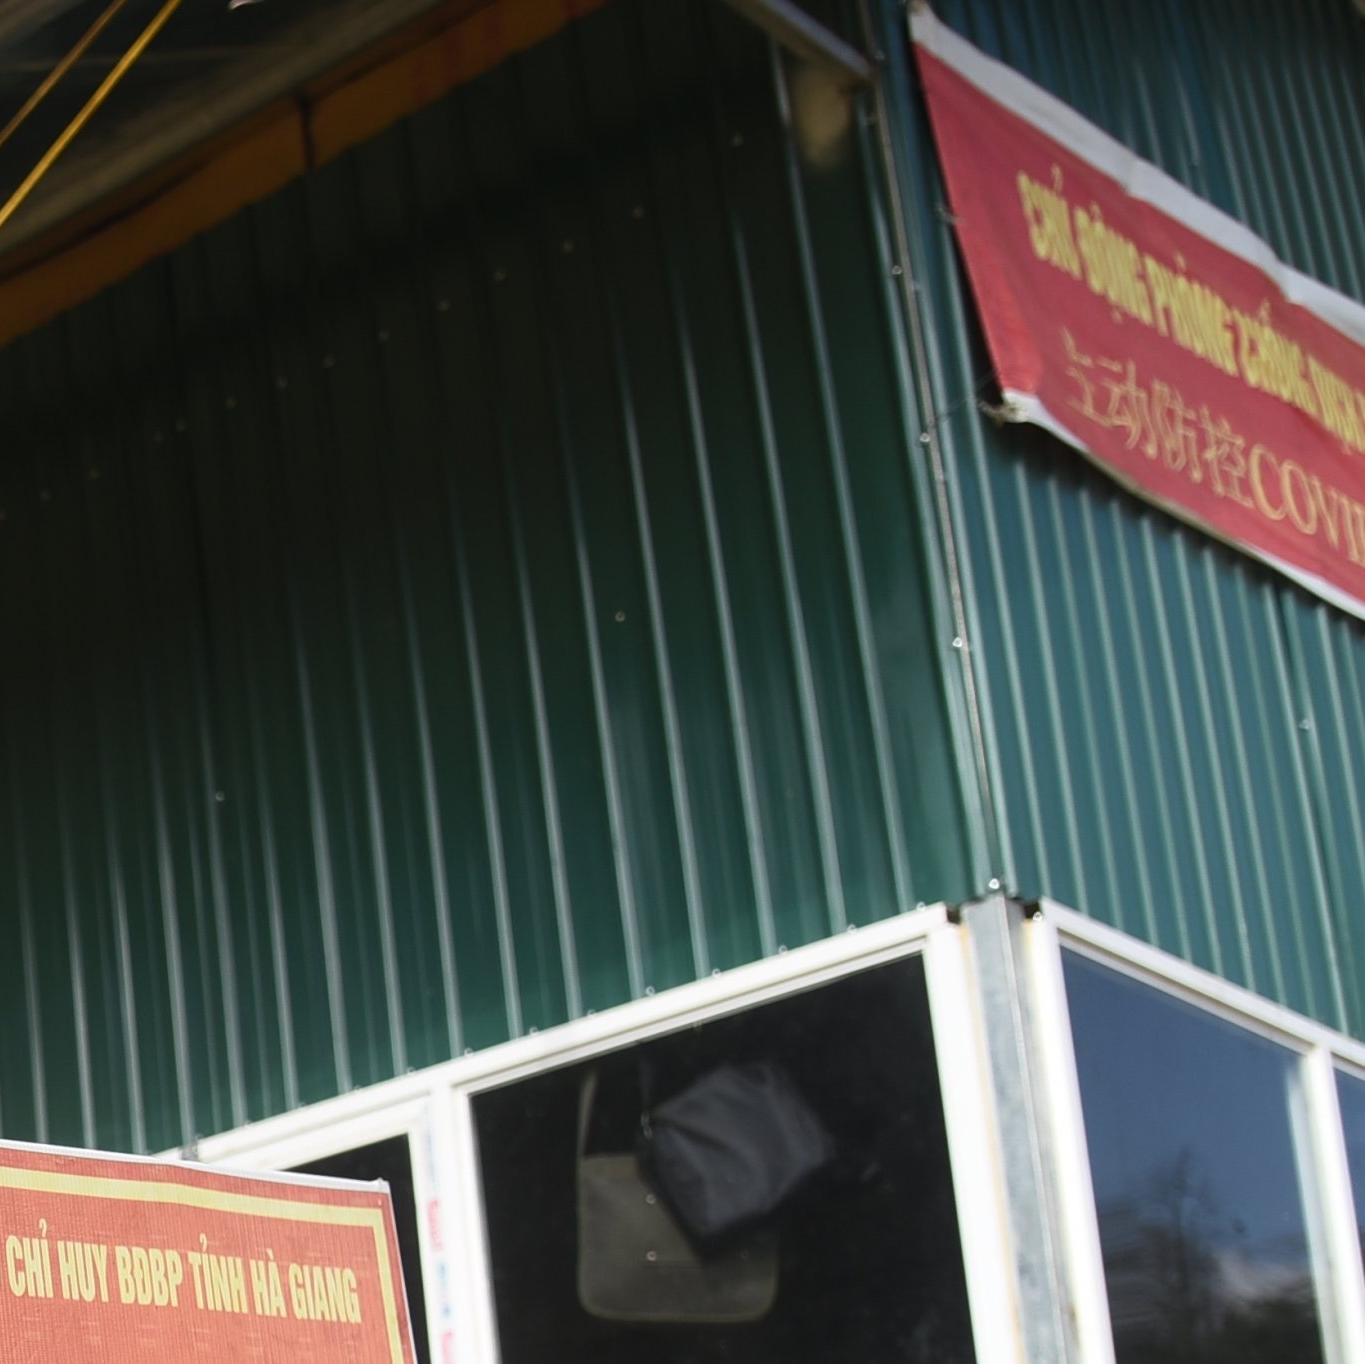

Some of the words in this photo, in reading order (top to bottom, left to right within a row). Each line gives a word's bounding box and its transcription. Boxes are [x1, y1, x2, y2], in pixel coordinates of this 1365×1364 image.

[1142, 252, 1240, 380] PHÒNG
[6, 1220, 53, 1296] CHỈ
[58, 1242, 108, 1301] HUY
[116, 1247, 182, 1305] BĐBP
[189, 1236, 247, 1312] TỈNH
[251, 1248, 286, 1315] HÀ
[289, 1264, 361, 1322] GIANG
